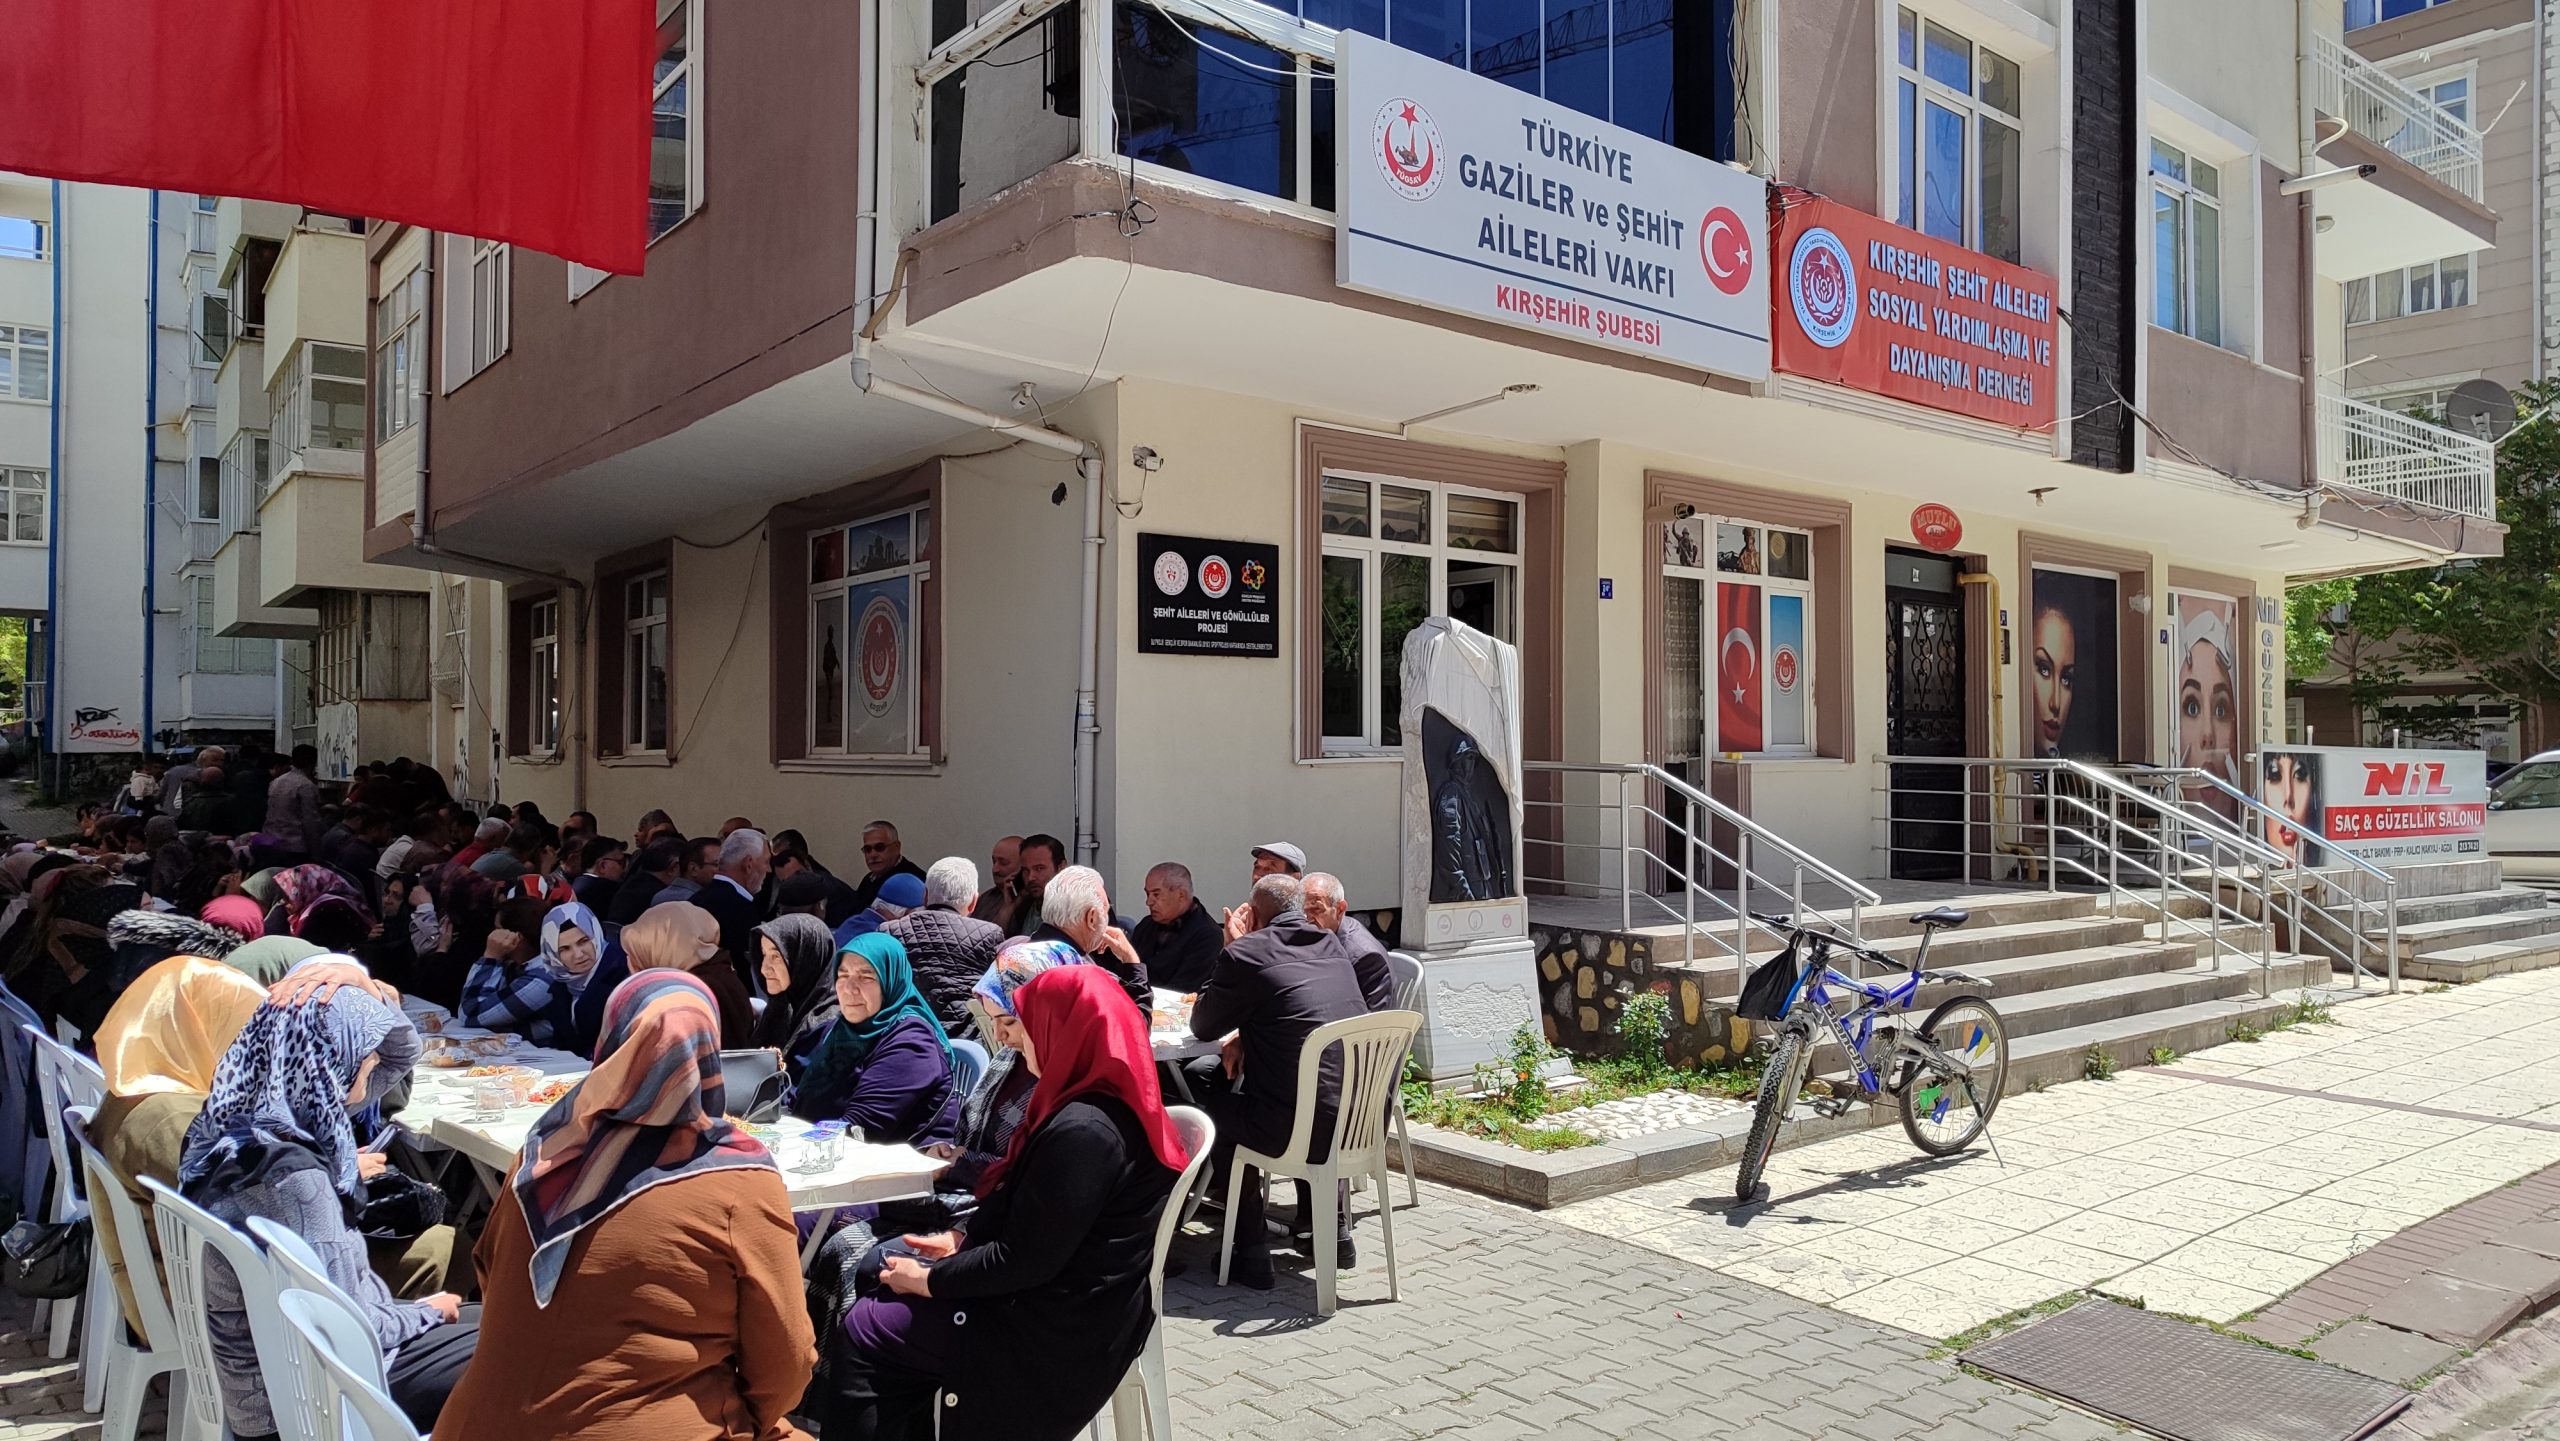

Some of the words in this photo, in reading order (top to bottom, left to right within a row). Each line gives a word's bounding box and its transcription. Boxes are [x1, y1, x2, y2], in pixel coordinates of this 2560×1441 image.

[1521, 117, 1633, 184] TÜRKİYE
[1459, 153, 1575, 218] GAZİLER
[1583, 199, 1609, 228] ve
[1616, 201, 1685, 251] ŞEHİT
[1477, 213, 1597, 278] AİLELERİ
[1605, 251, 1675, 298] VAKFI
[1869, 239, 1941, 288] KIRŞEHİR
[1947, 265, 1988, 303] ŞEHİT
[1992, 276, 2049, 324] AİLELERİ
[1496, 284, 1590, 330] KIRŞEHİR
[1596, 309, 1661, 347] ŞUBESİ
[1868, 287, 1927, 332] SOSYAL
[1933, 306, 2030, 361] YARDIMLAŞMA
[2033, 336, 2050, 367] VE
[1890, 342, 1972, 391] DAYANIŞMA
[1977, 365, 2033, 406] DERNEĞİ
[1153, 606, 1176, 619] ŞEHİT
[1177, 606, 1210, 620] AİLELERİ
[1211, 611, 1221, 620] VE
[1222, 610, 1270, 623] GÖNÜLLÜLER
[1197, 622, 1228, 633] PROJESİ
[2335, 814, 2360, 837] SAÇ
[2363, 816, 2372, 831] &
[2376, 807, 2436, 830] GÜZELLİK
[2438, 810, 2481, 828] SALONU
